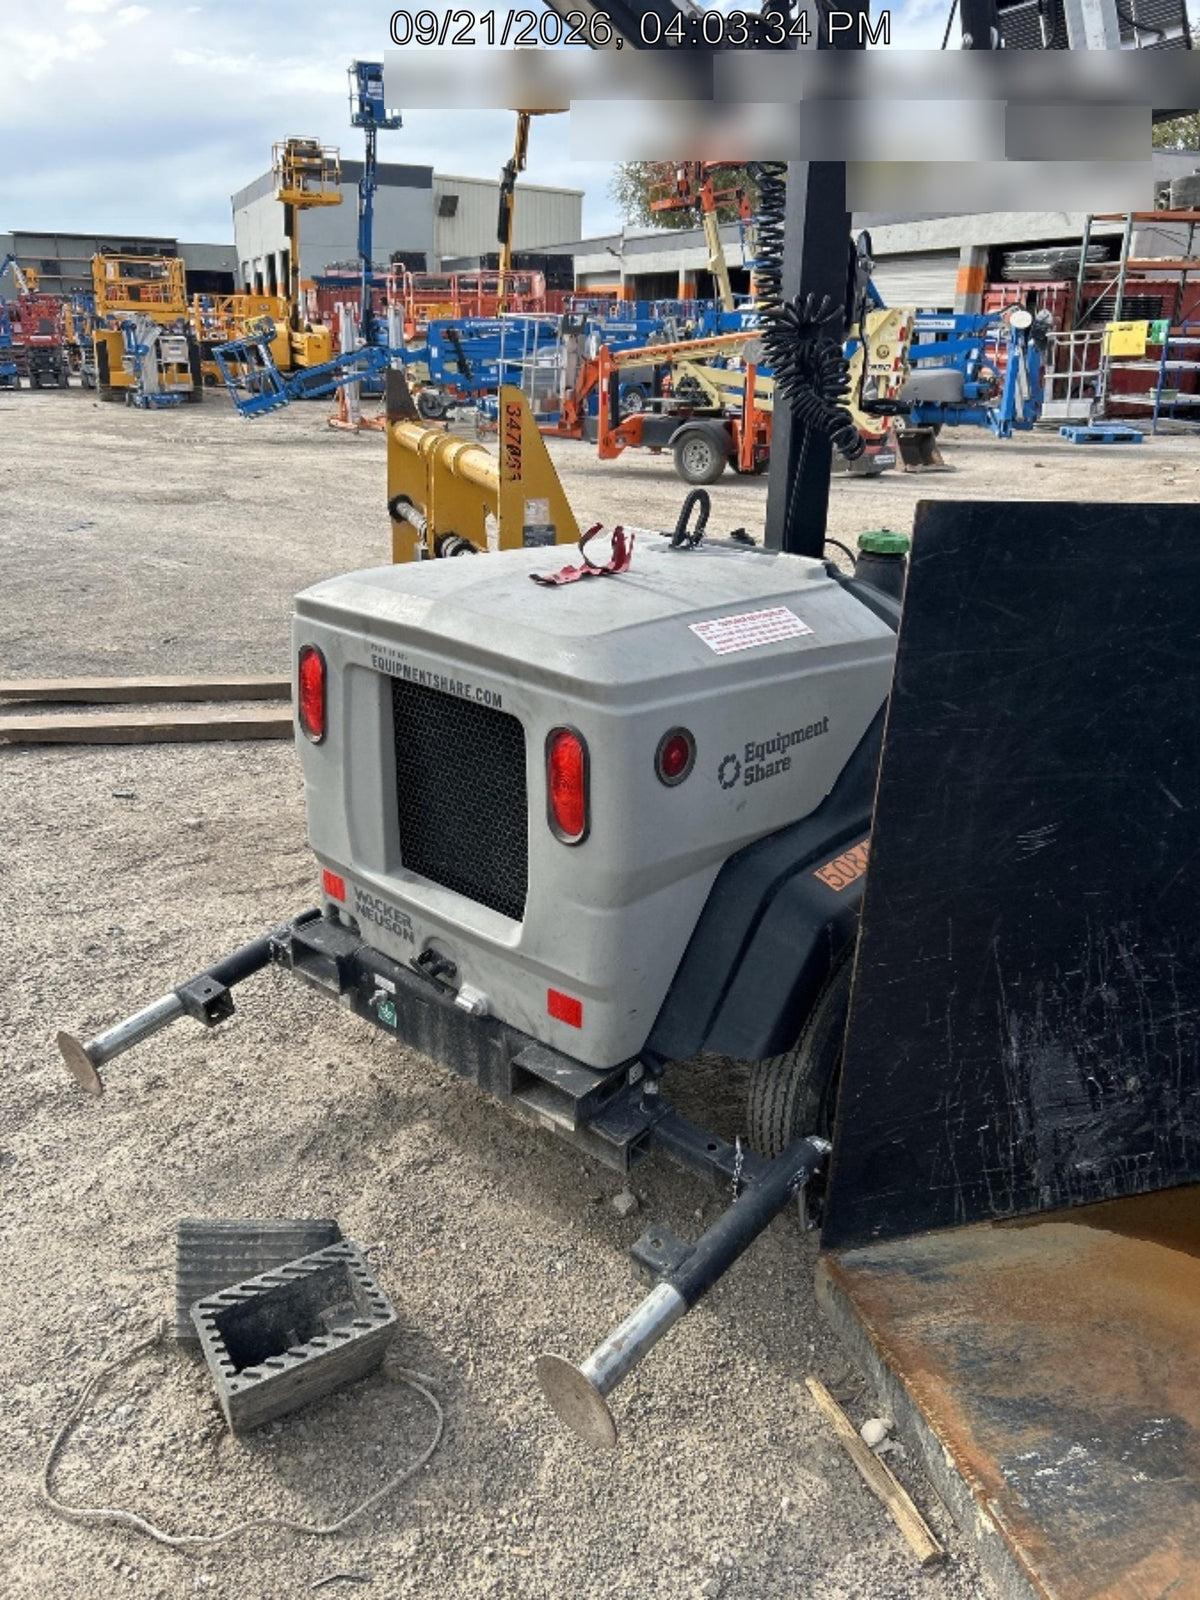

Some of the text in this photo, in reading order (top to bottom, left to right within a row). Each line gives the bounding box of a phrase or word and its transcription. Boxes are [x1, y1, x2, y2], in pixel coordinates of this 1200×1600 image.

[371, 653, 502, 708] EQUIPMENTSHARE.COM
[745, 716, 830, 763] Equipment
[744, 756, 792, 786] Share
[354, 886, 413, 930] WACKER
[355, 901, 415, 945] NEUSON
